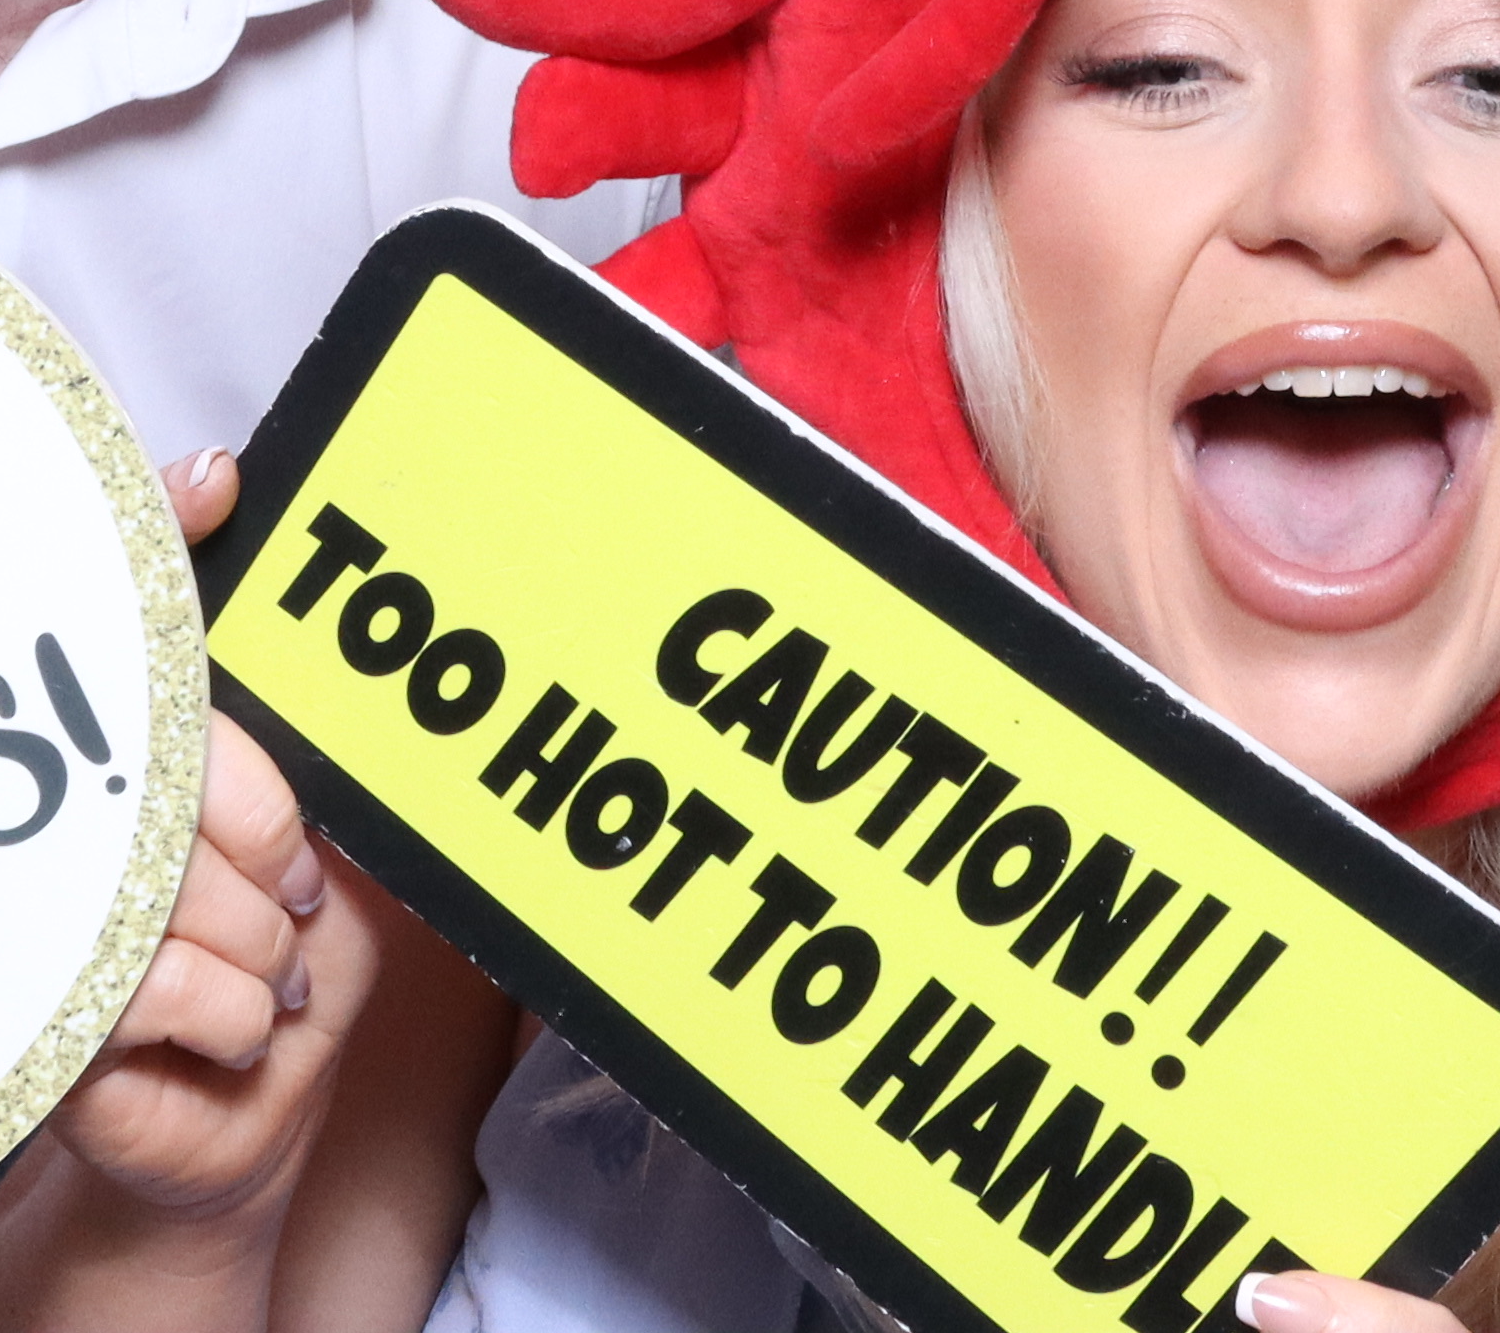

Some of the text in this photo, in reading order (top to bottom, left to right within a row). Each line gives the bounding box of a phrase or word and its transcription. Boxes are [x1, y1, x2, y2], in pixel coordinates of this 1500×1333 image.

[275, 502, 506, 736] TOO
[478, 680, 753, 922] HOT
[708, 852, 881, 1045] TO
[655, 587, 1289, 1091] CAUTION!!
